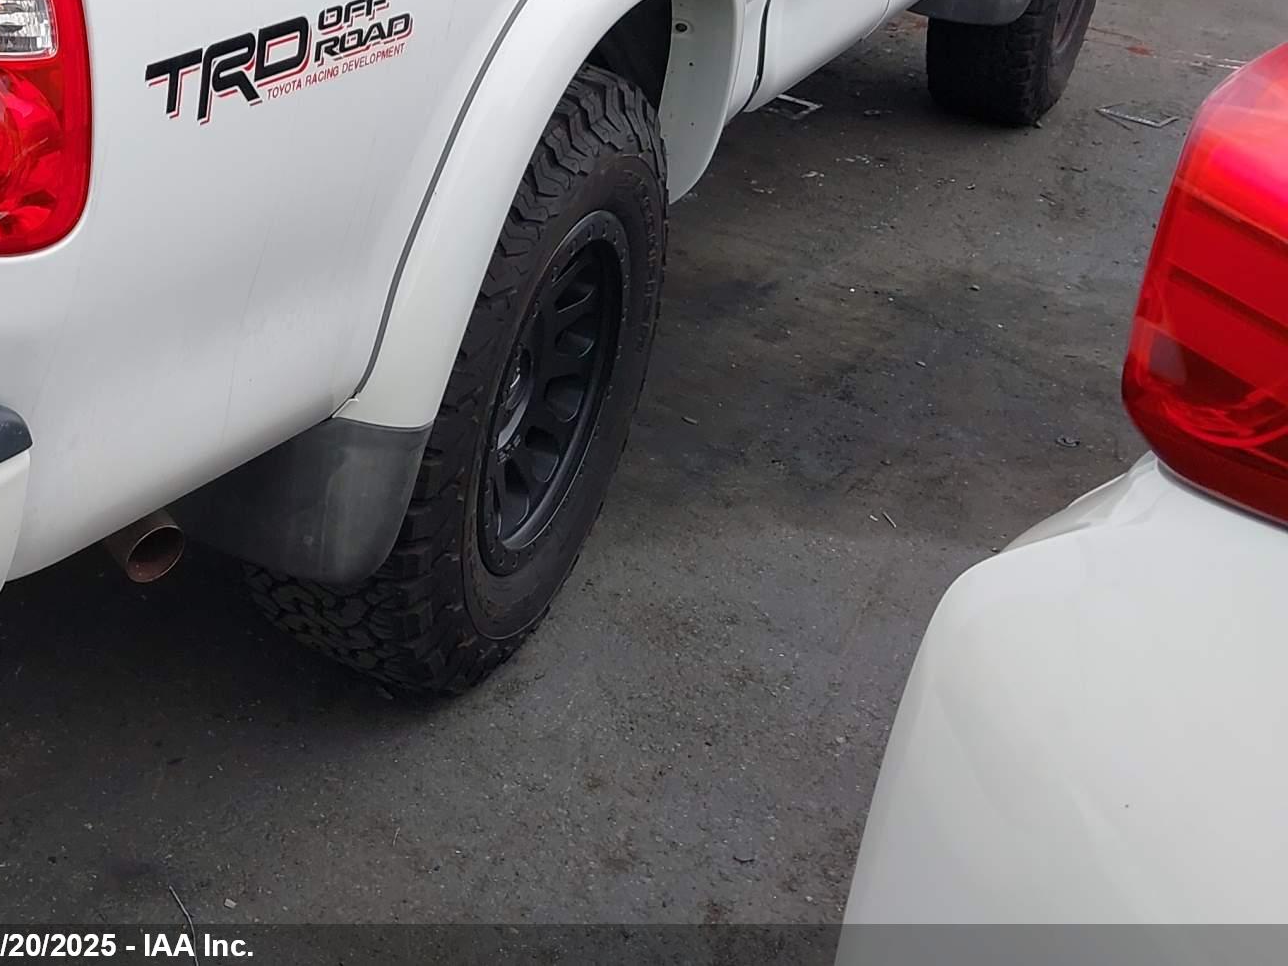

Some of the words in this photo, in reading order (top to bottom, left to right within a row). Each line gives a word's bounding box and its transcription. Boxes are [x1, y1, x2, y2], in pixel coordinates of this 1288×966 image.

[314, 12, 414, 66] ROAD
[145, 15, 313, 126] TRD
[267, 80, 302, 101] TOYOTA
[304, 66, 340, 87] RACING
[341, 42, 407, 75] DEVELOPMENT
